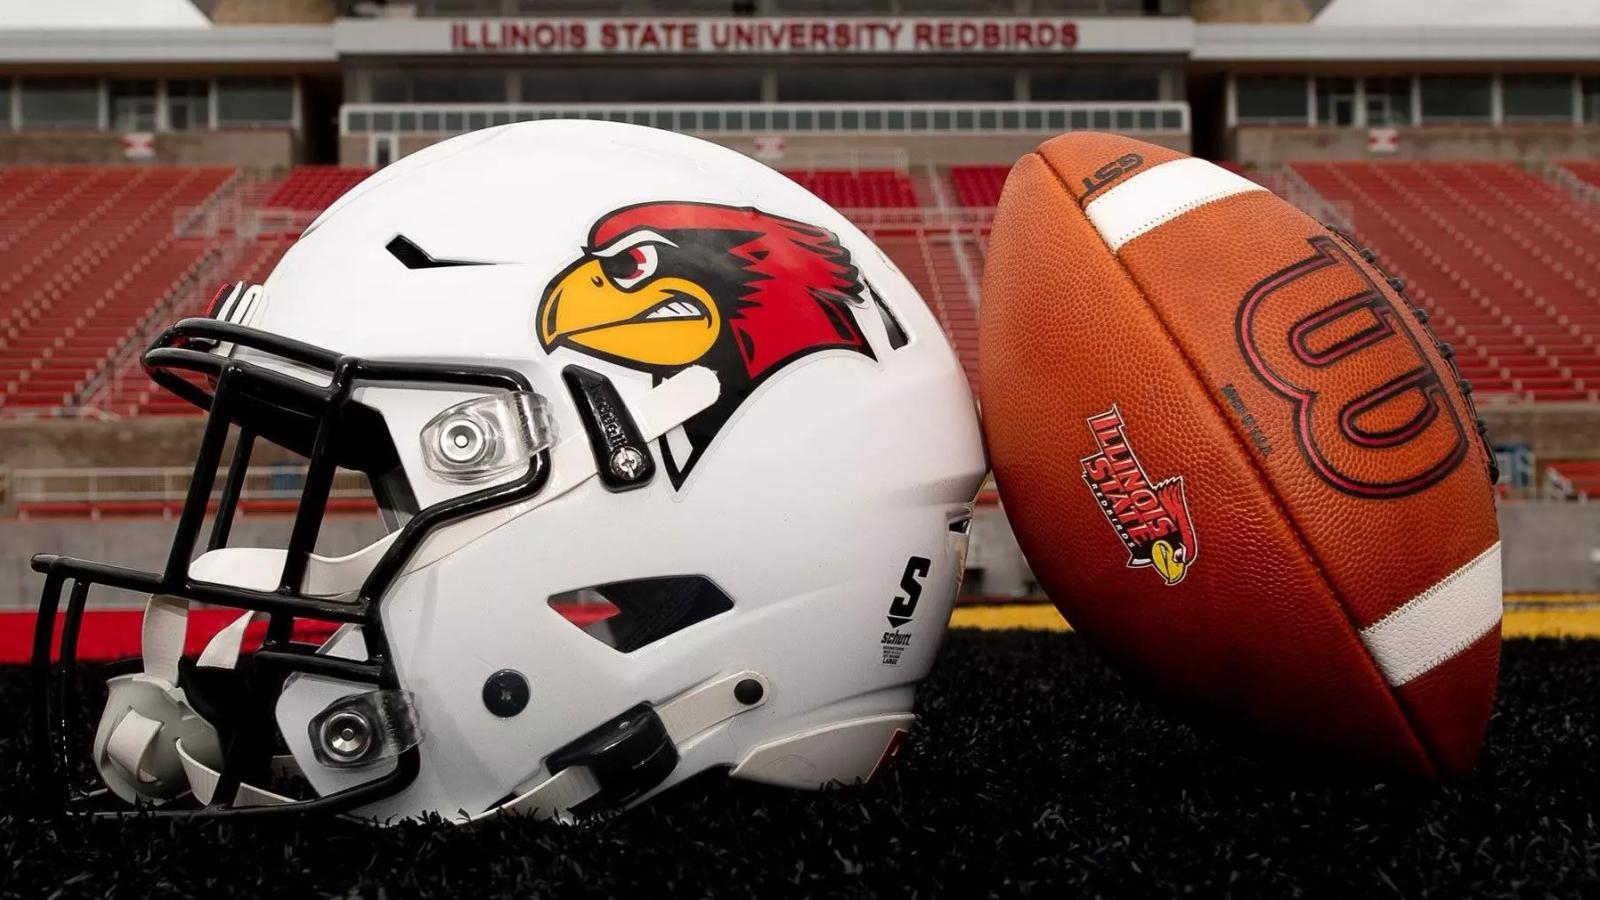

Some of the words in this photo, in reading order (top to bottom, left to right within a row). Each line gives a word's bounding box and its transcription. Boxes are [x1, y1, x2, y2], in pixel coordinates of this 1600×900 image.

[452, 23, 588, 49] ILLINOIS
[601, 23, 699, 49] STATE
[711, 23, 902, 49] UNIVERSITY
[914, 23, 1079, 48] REDBIRDS
[1080, 153, 1144, 196] GST
[1087, 456, 1151, 548] STATE
[1091, 413, 1178, 540] ILLINOIS
[1091, 483, 1135, 549] REDBIRDS
[881, 629, 912, 646] schutt
